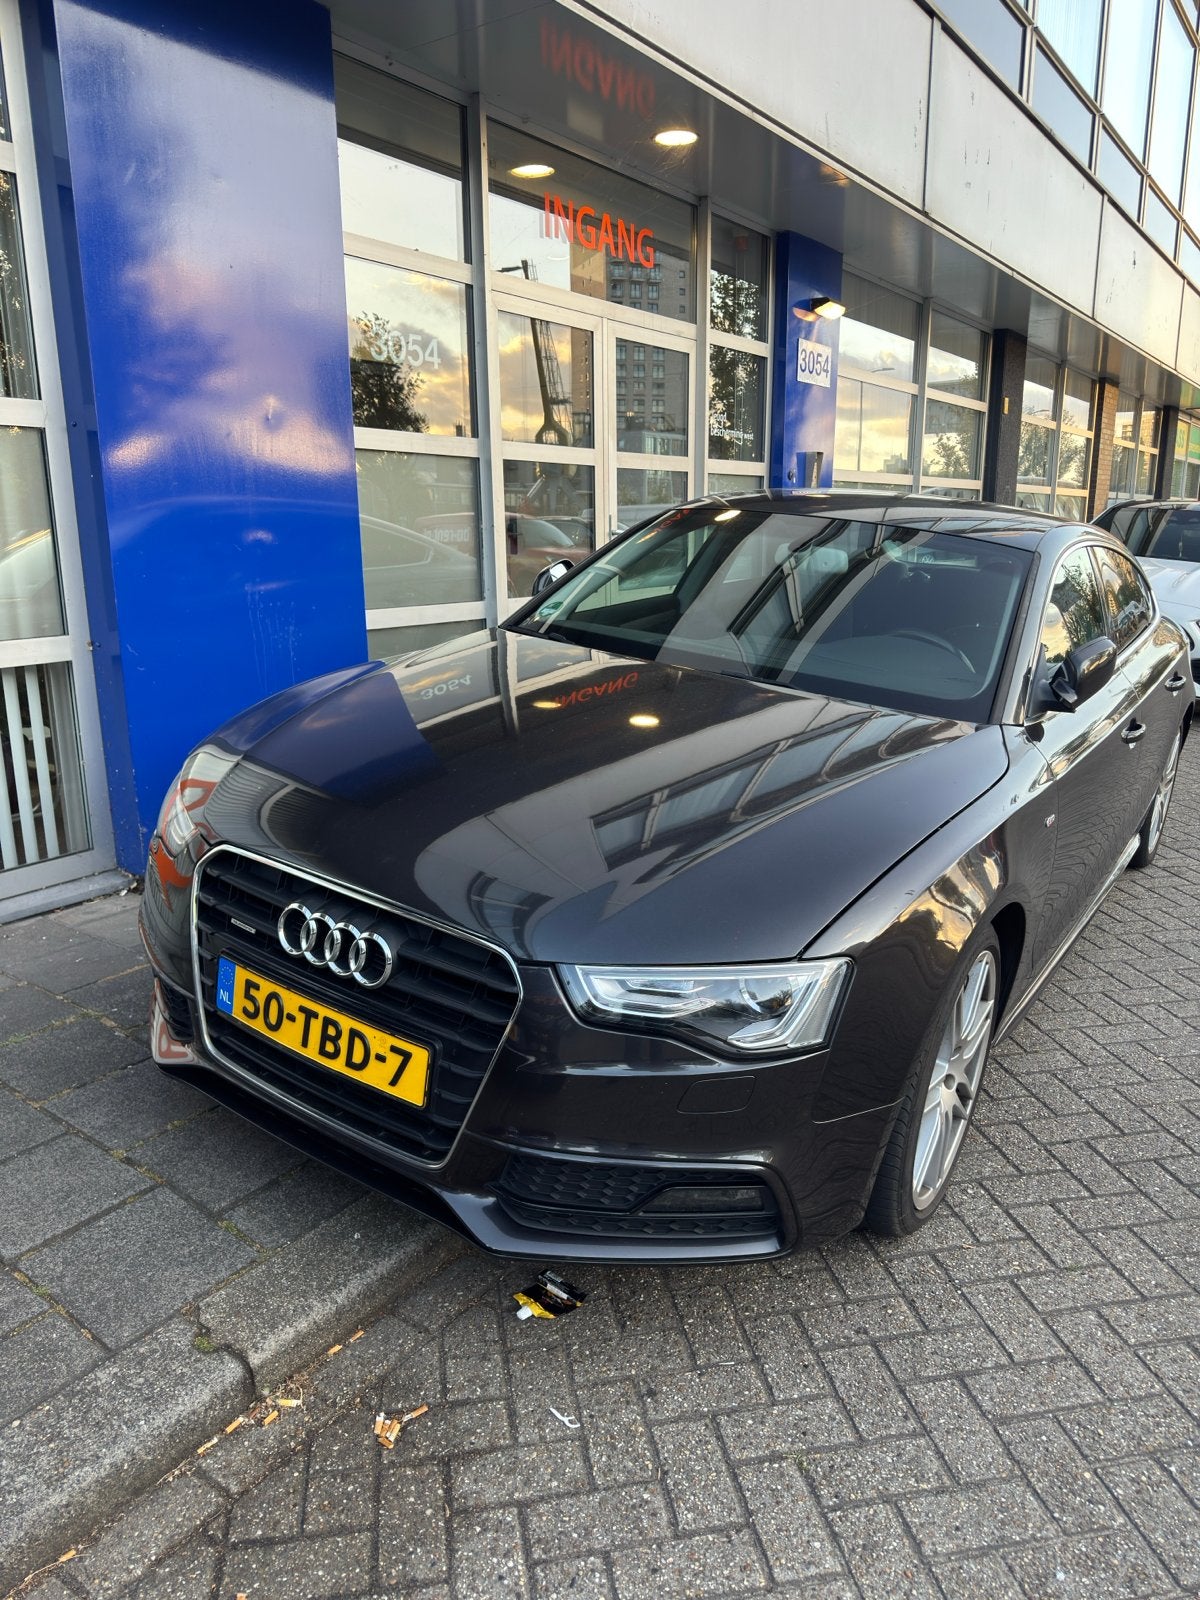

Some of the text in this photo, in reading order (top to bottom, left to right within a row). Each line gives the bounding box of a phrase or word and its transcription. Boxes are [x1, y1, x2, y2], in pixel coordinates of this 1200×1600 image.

[543, 191, 655, 269] INGANG
[371, 327, 442, 369] 3054
[799, 348, 830, 379] 3054
[219, 988, 231, 1005] NL
[242, 977, 413, 1087] 50-TBD-7
